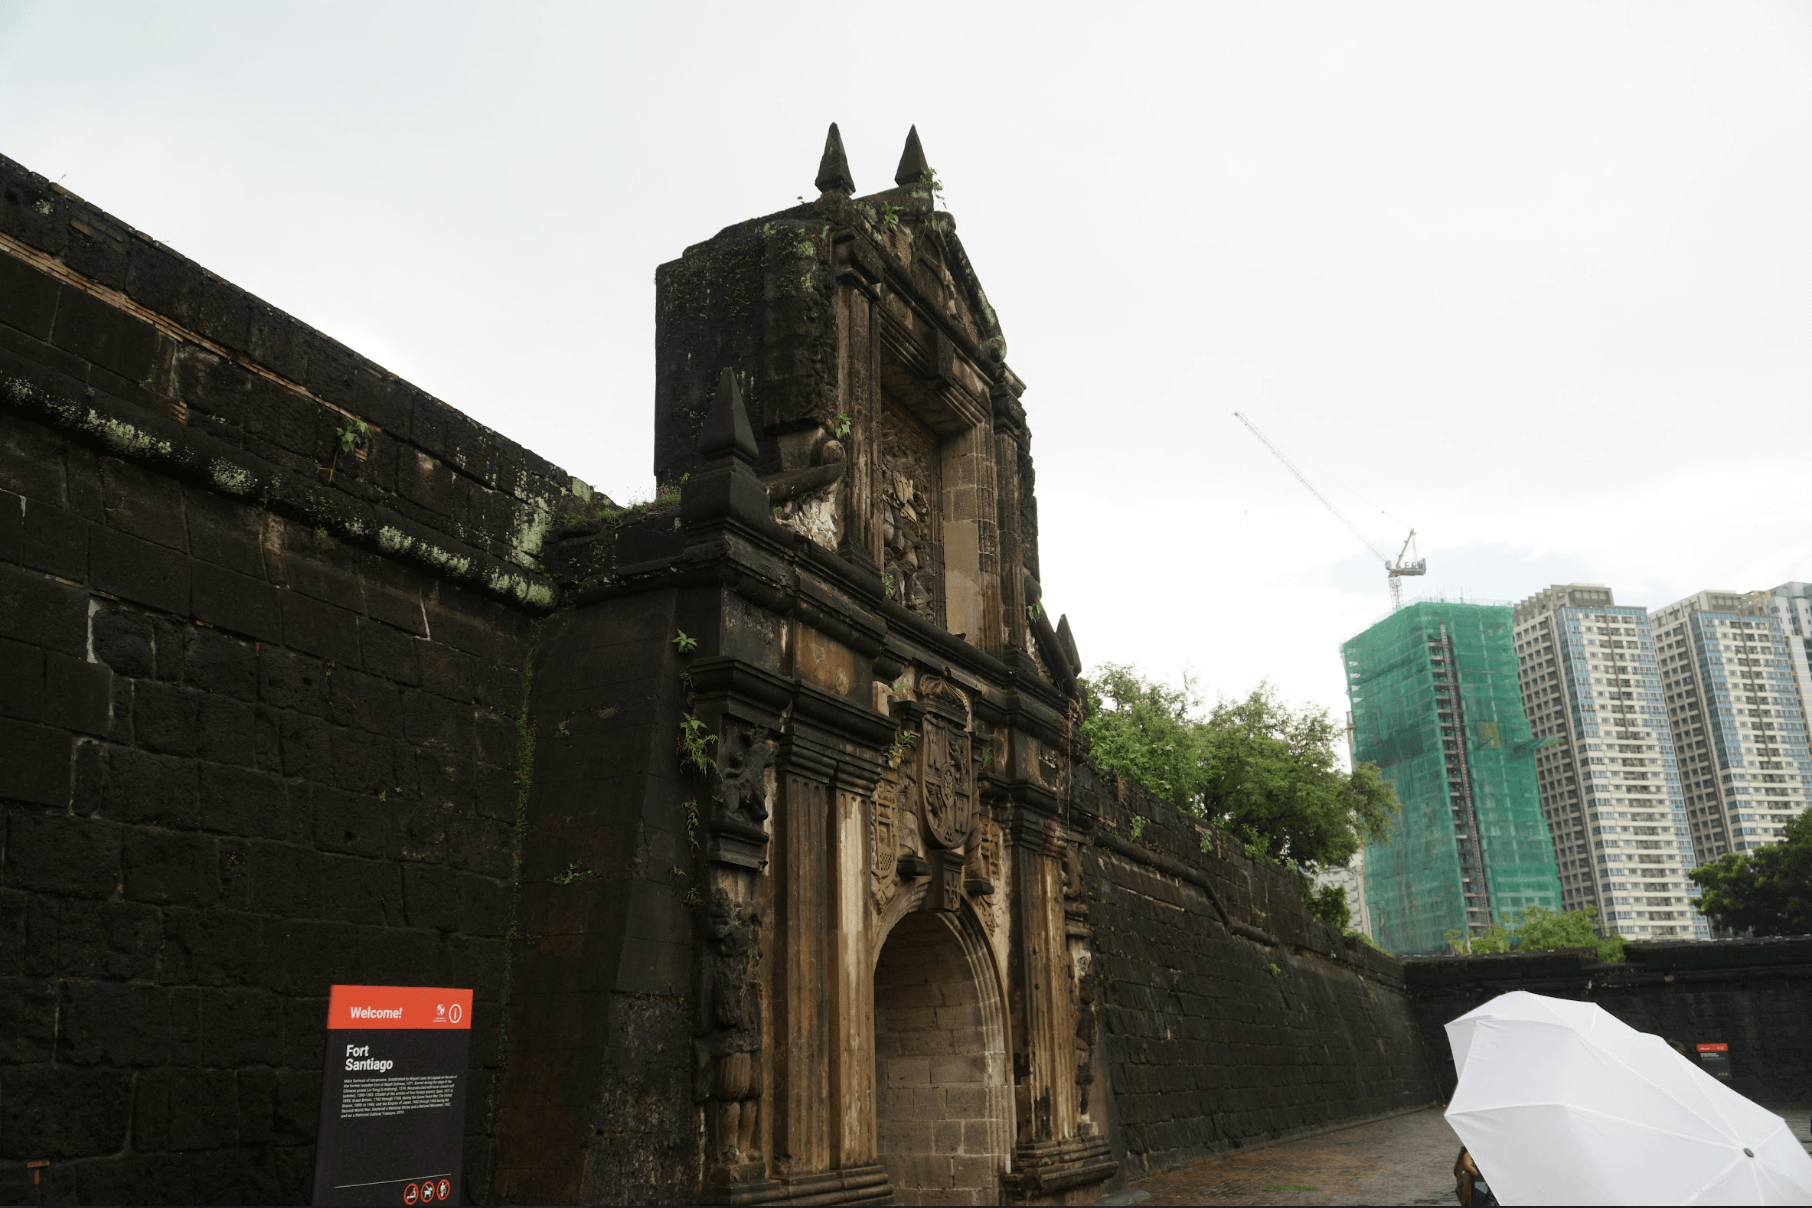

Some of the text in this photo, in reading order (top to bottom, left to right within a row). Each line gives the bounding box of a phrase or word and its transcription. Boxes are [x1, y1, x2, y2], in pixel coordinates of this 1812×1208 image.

[350, 1006, 403, 1019] Welcome!
[346, 1044, 370, 1057] Fort
[345, 1058, 393, 1073] Santiago
